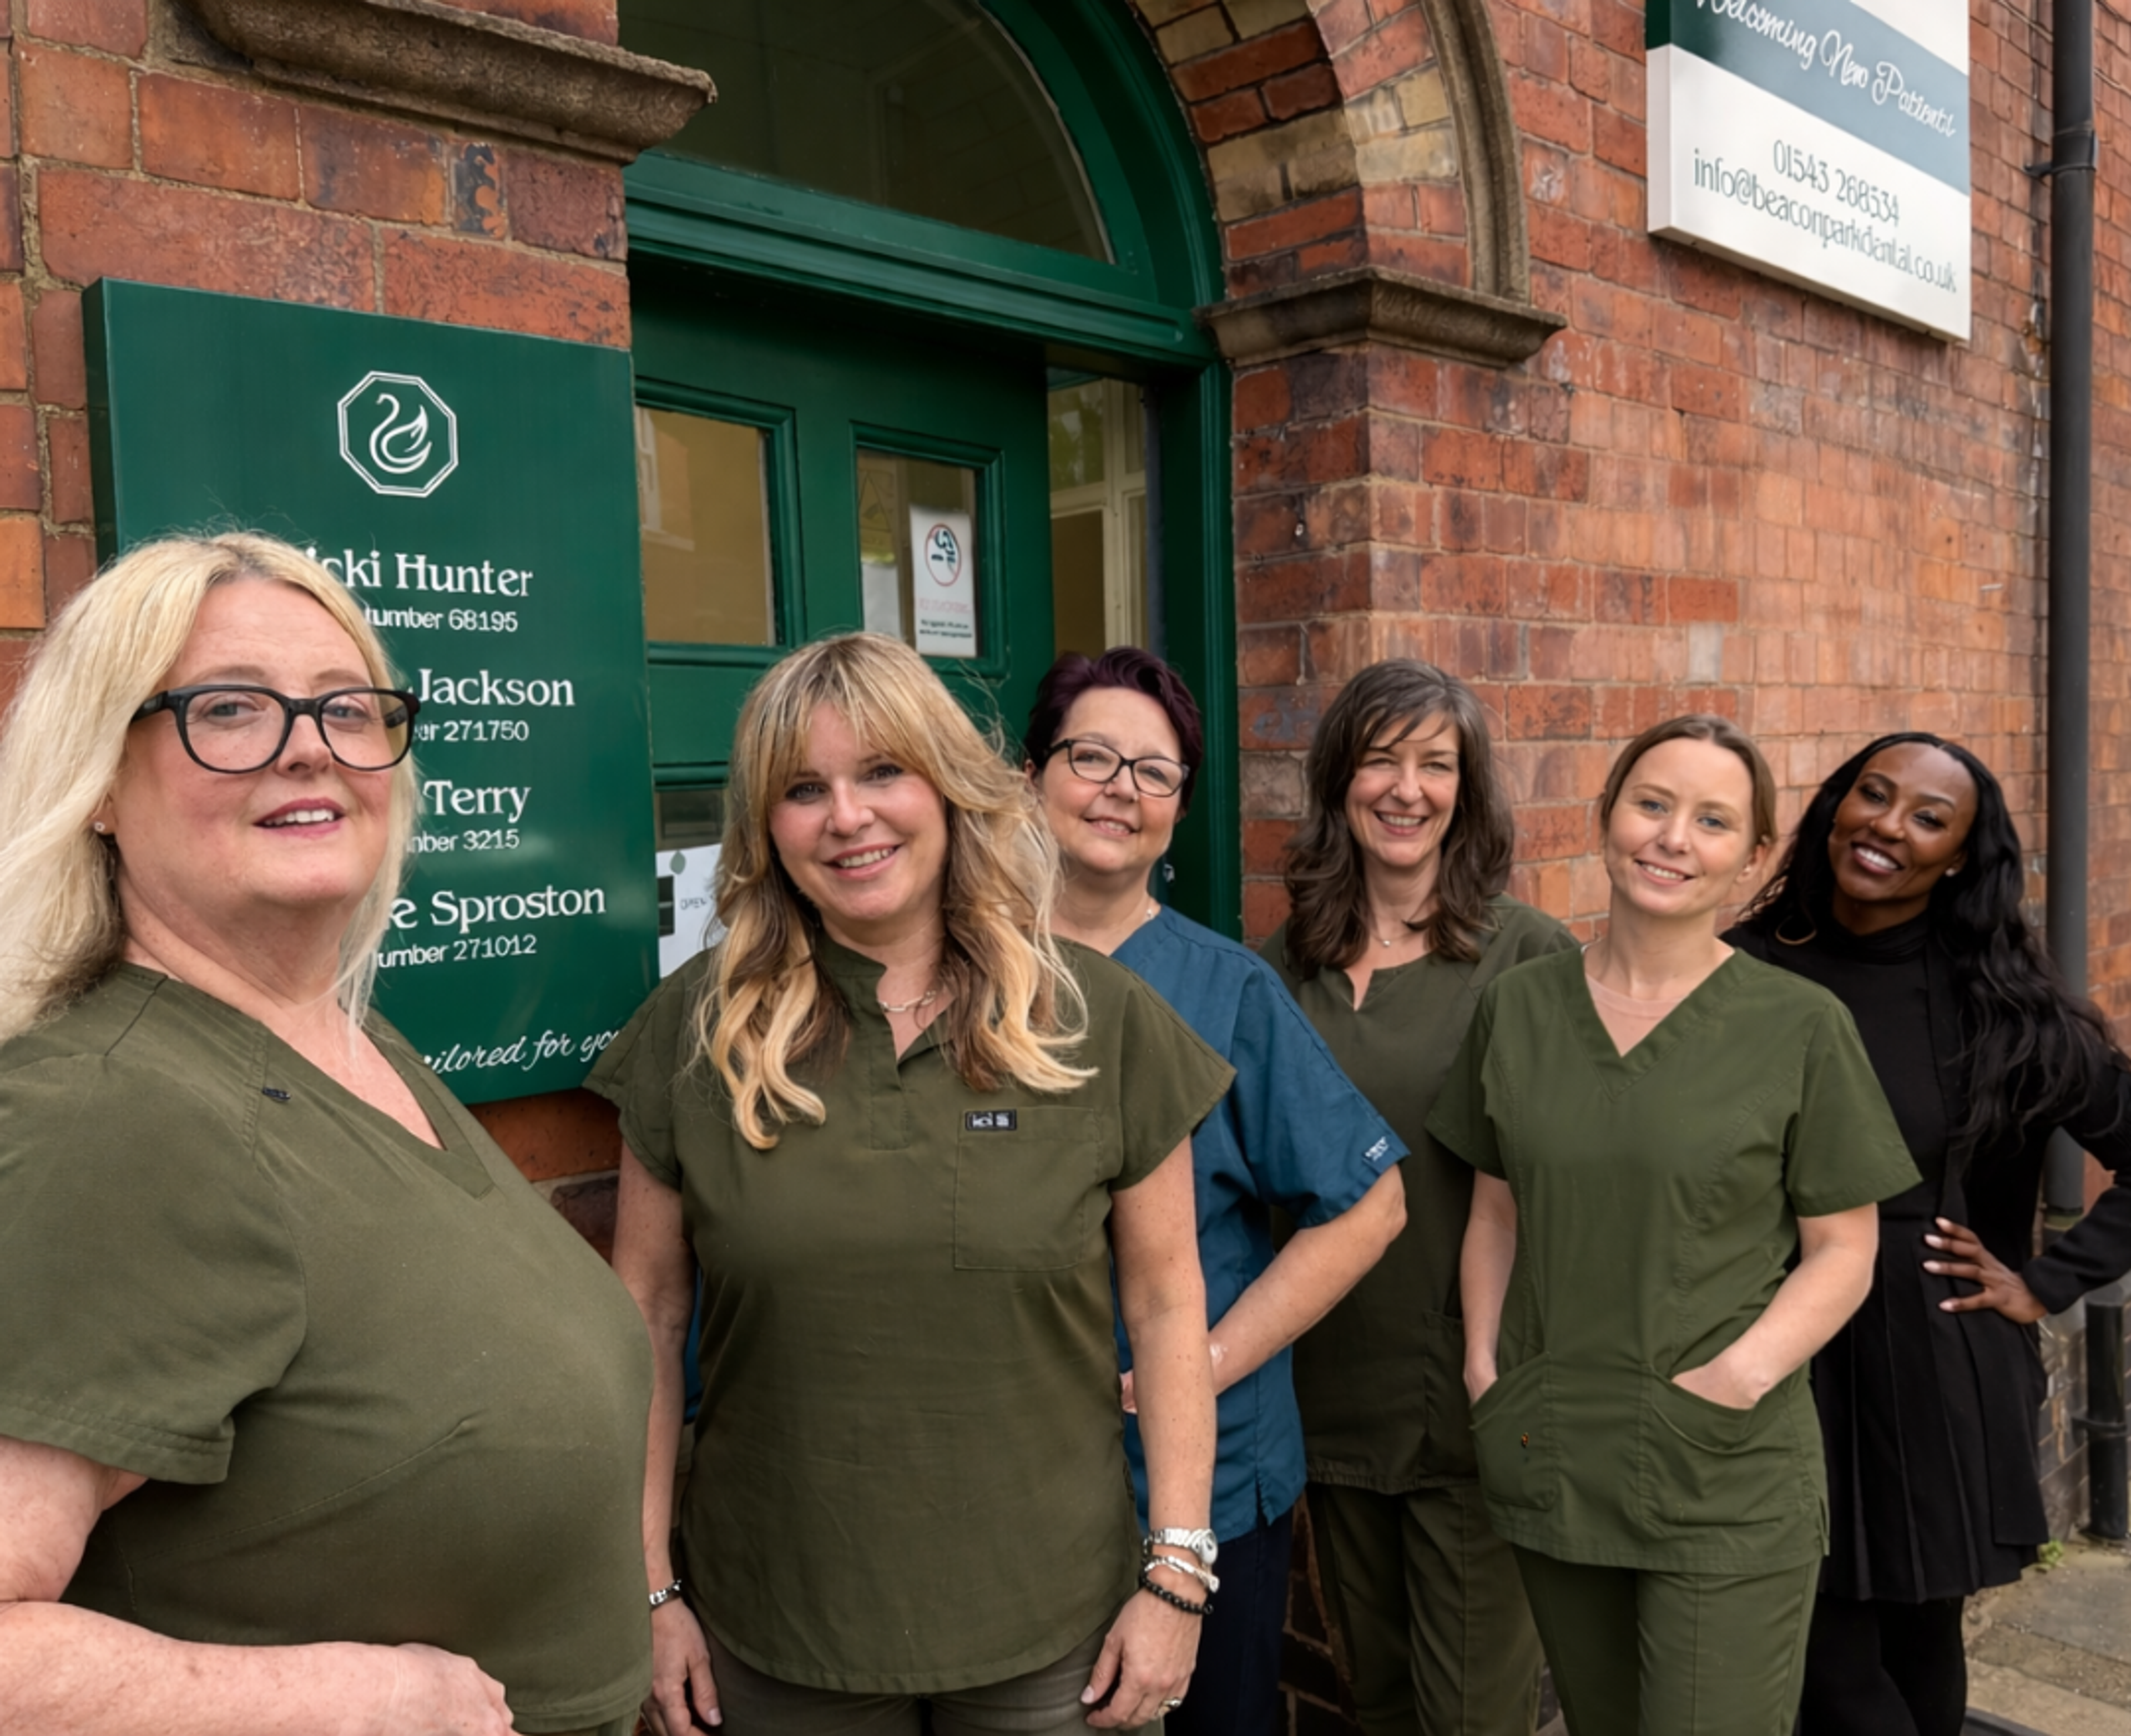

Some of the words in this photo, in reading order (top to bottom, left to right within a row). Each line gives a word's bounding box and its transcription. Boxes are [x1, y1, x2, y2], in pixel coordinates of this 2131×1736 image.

[1696, 0, 1817, 70] elcoming
[1819, 29, 1869, 89] New
[1774, 139, 1830, 193] 01543
[1836, 169, 1900, 227] 268534
[1694, 148, 1957, 293] info@beaconparkdental.co.uk
[395, 553, 533, 596] Hunter
[448, 609, 518, 632] 68195
[418, 669, 575, 706] Jackson
[443, 720, 529, 741] 271750
[422, 780, 531, 823] Terry
[463, 829, 520, 850] 3215
[430, 885, 607, 934] Sproston
[378, 945, 448, 968] umber
[453, 934, 537, 961] 271012
[522, 1029, 575, 1071] for
